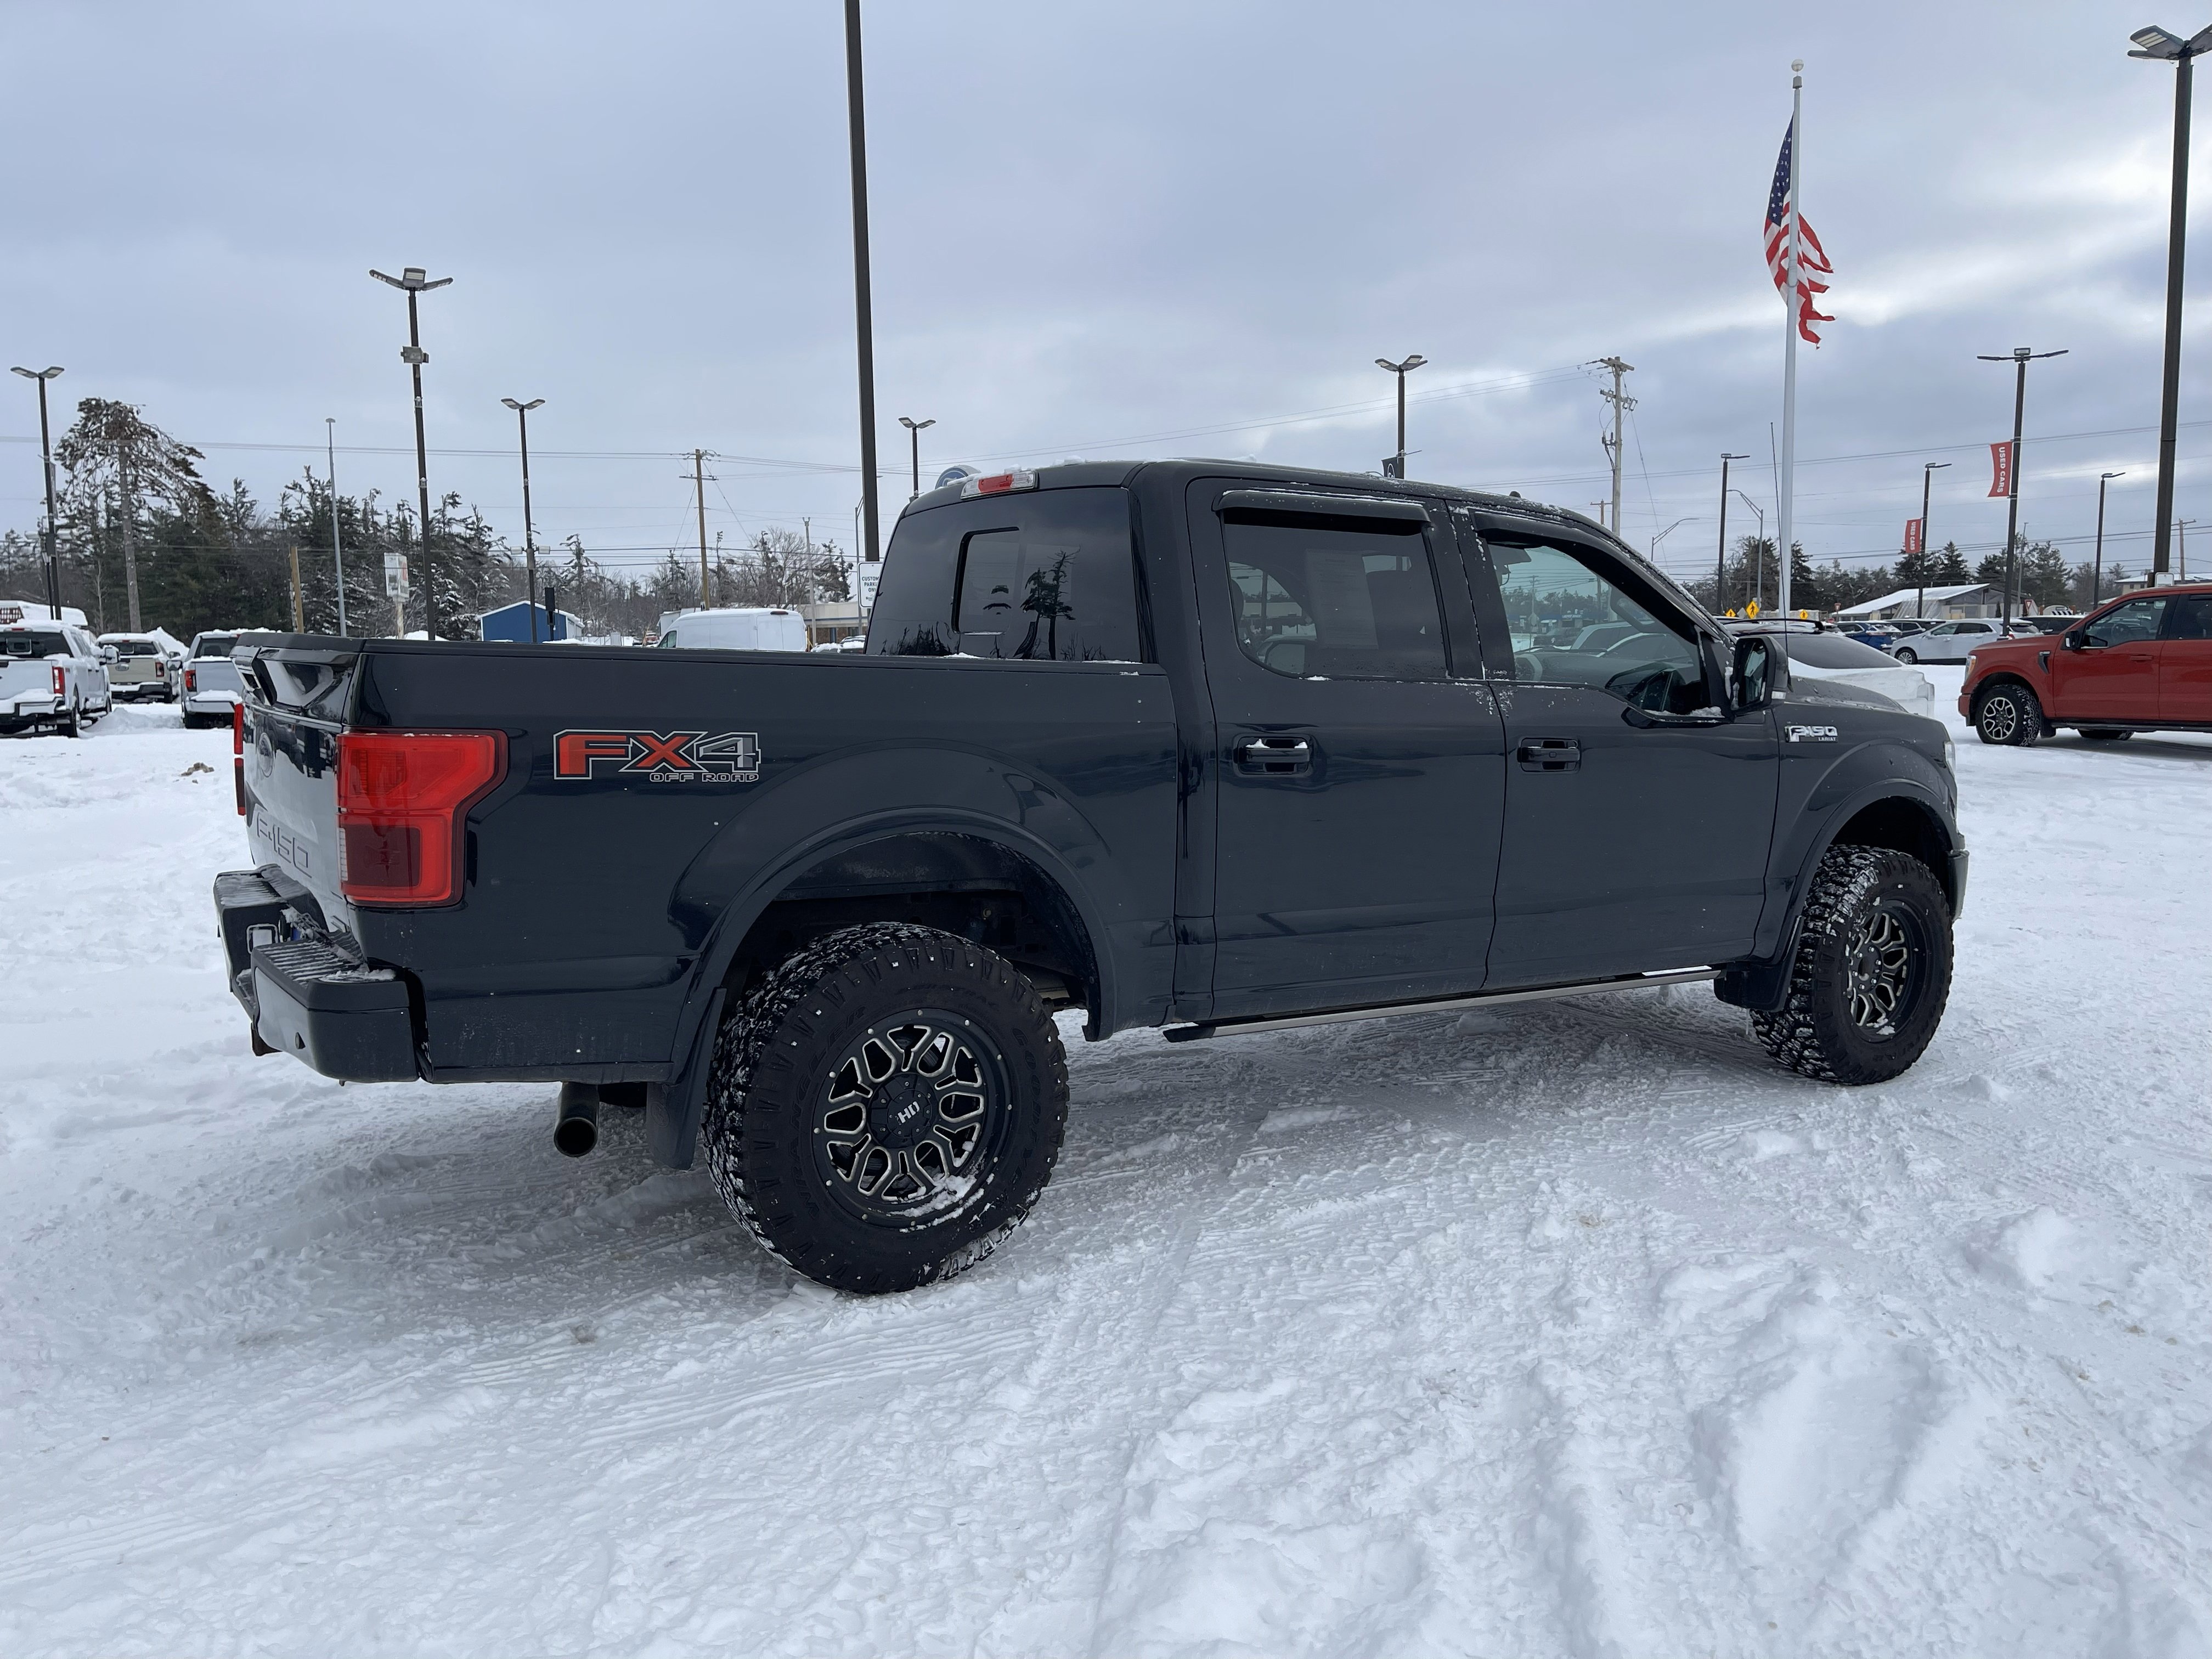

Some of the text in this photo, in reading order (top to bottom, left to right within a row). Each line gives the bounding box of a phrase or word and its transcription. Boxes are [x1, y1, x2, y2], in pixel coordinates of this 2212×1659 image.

[1997, 471, 2006, 493] CARS
[553, 729, 761, 780] FX4
[649, 772, 759, 782] OFF ROAD
[789, 1005, 866, 1219] WRANGLER
